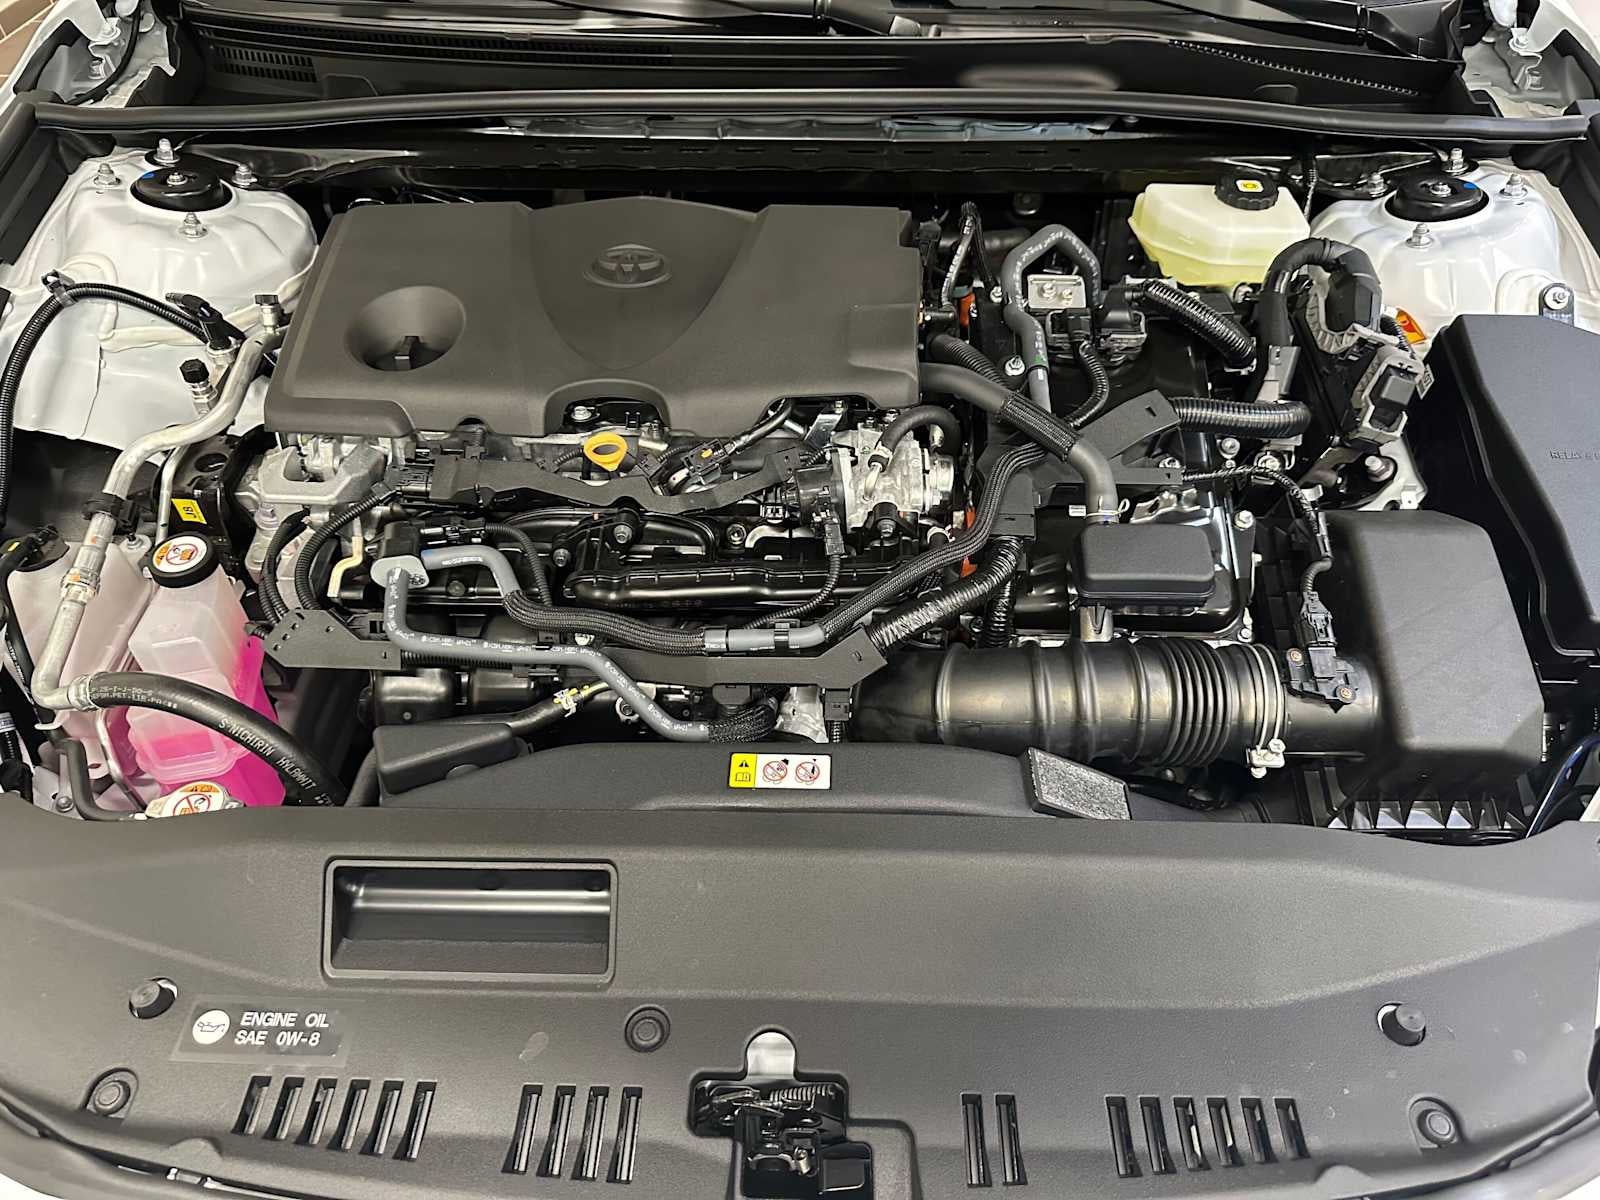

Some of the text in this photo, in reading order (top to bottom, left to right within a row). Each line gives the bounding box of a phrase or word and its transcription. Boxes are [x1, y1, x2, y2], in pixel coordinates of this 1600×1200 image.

[240, 1011, 330, 1028] ENGINE OIL
[234, 1029, 268, 1046] SAE
